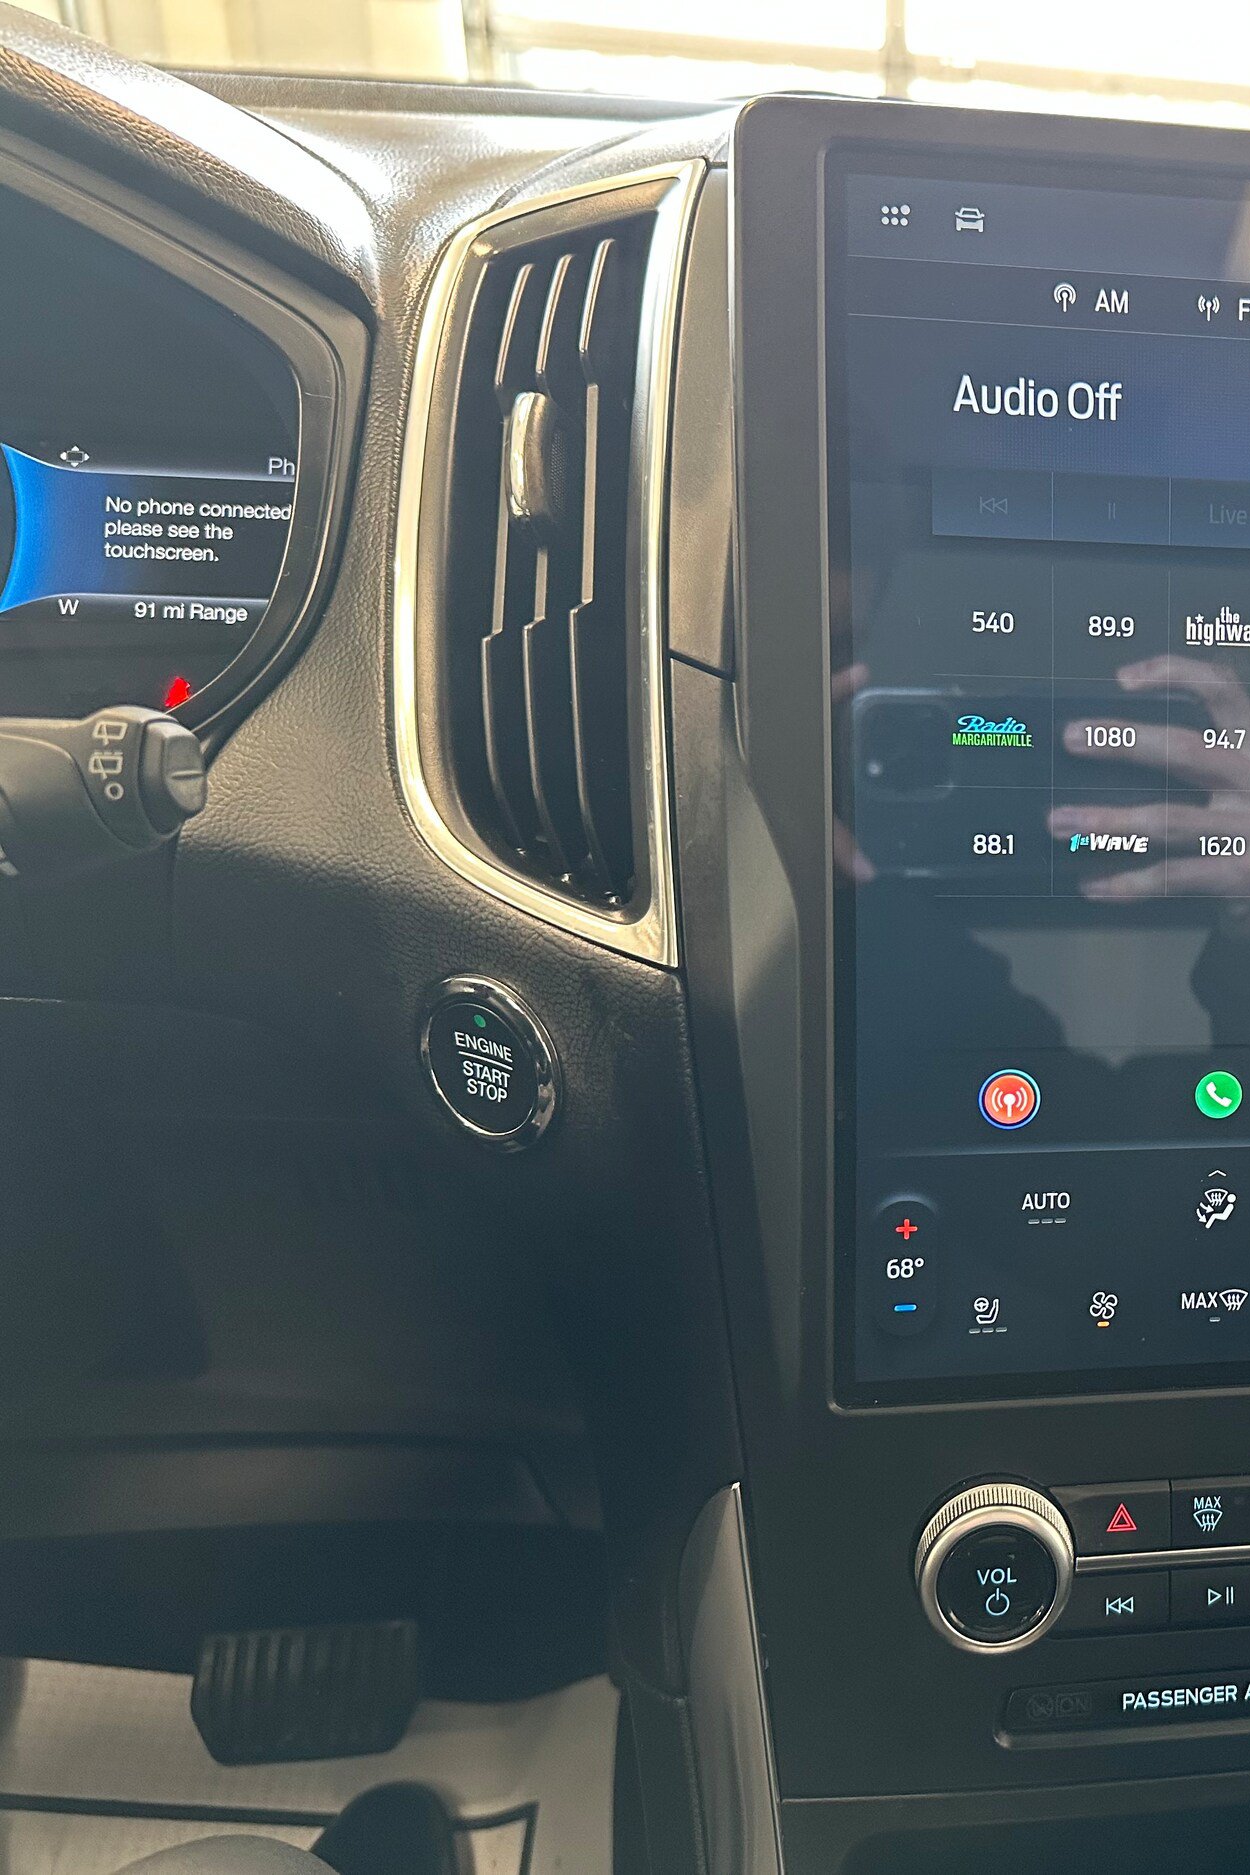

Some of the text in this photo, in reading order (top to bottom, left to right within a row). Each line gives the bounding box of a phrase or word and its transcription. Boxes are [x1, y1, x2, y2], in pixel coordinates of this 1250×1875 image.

[1094, 288, 1129, 314] AM
[953, 374, 1123, 421] Audio Off
[105, 496, 292, 520] No phone connected
[1208, 503, 1248, 526] Live
[104, 519, 234, 541] please see the
[104, 543, 220, 563] touchscreen.
[59, 599, 79, 616] W
[134, 602, 248, 624] 91 mi Range
[1220, 606, 1240, 624] the
[972, 611, 1015, 633] 540
[1088, 615, 1135, 637] 89.9
[957, 715, 1027, 734] Radio
[952, 733, 1033, 747] MARGARITAVILLE
[1085, 726, 1136, 747] 1080
[1203, 729, 1246, 750] 94.7
[973, 834, 1015, 855] 88.1
[1199, 836, 1246, 856] 1620
[454, 1031, 513, 1063] ENGINE
[463, 1060, 511, 1088] START
[467, 1079, 508, 1103] STOP
[1021, 1191, 1071, 1211] AUTO
[1181, 1291, 1219, 1310] MAX
[1193, 1496, 1222, 1510] MAX
[976, 1567, 1017, 1586] VOL
[1122, 1684, 1237, 1711] PASSENGER
